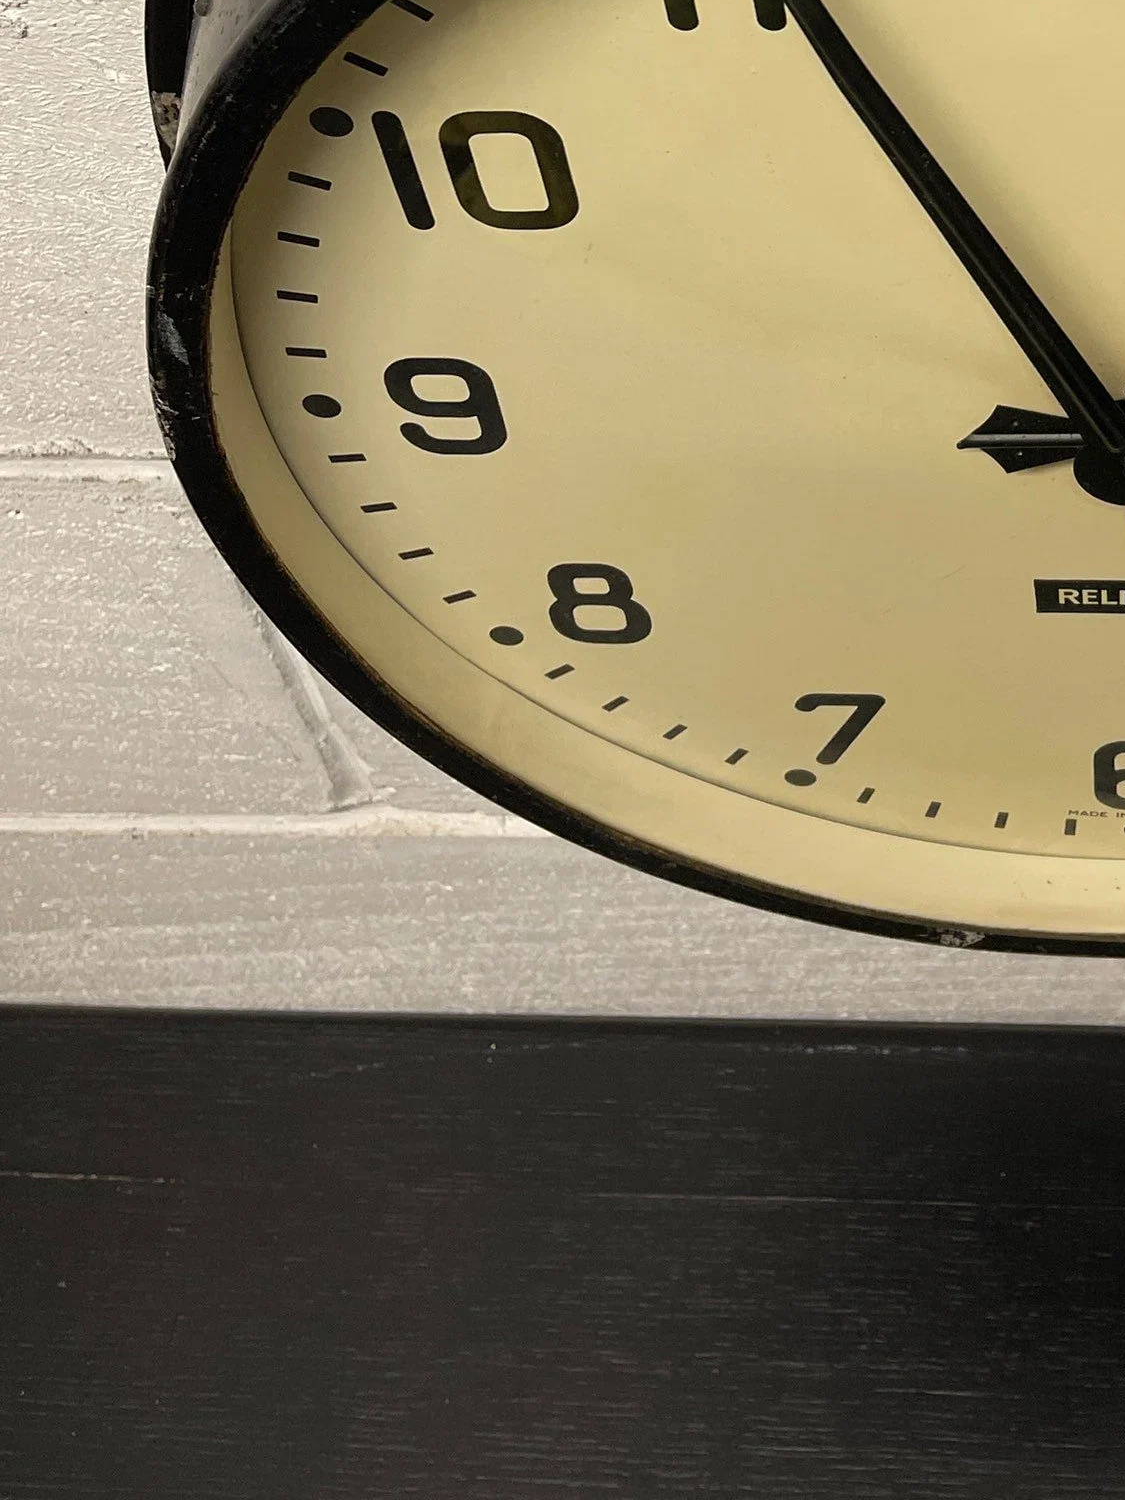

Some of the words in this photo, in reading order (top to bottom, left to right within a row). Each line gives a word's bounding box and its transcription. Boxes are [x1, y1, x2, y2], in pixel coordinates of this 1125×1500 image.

[371, 109, 580, 231] 10
[384, 357, 508, 455] 9
[547, 563, 653, 644] 8
[794, 693, 887, 764] 7
[1068, 809, 1108, 818] MADE
